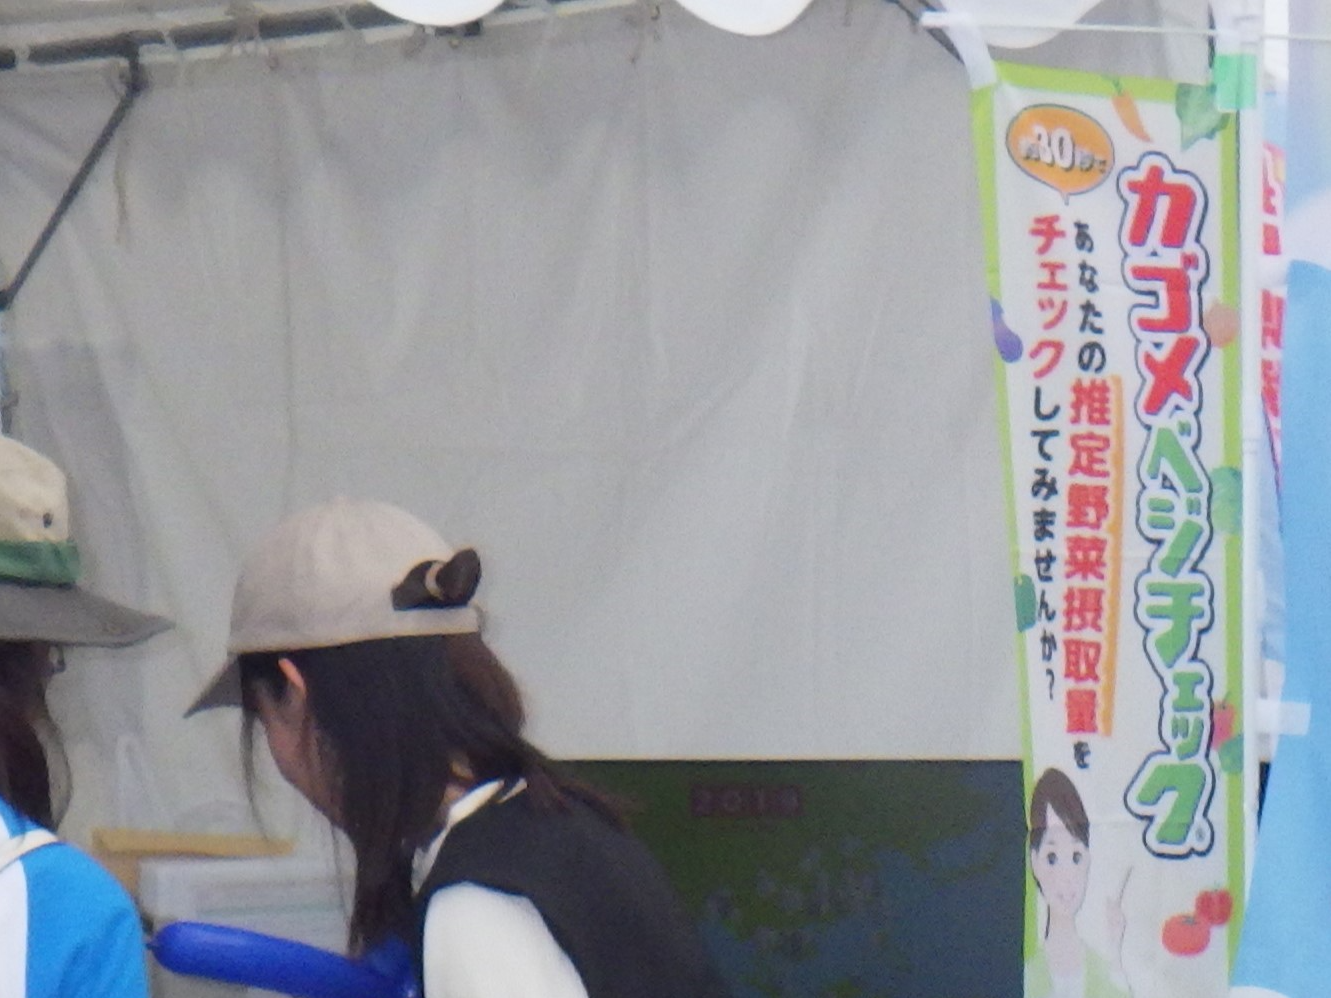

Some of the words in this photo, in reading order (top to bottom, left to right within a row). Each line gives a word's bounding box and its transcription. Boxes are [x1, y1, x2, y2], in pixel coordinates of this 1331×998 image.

[1063, 219, 1111, 769] あなたの推定野菜摂取量を
